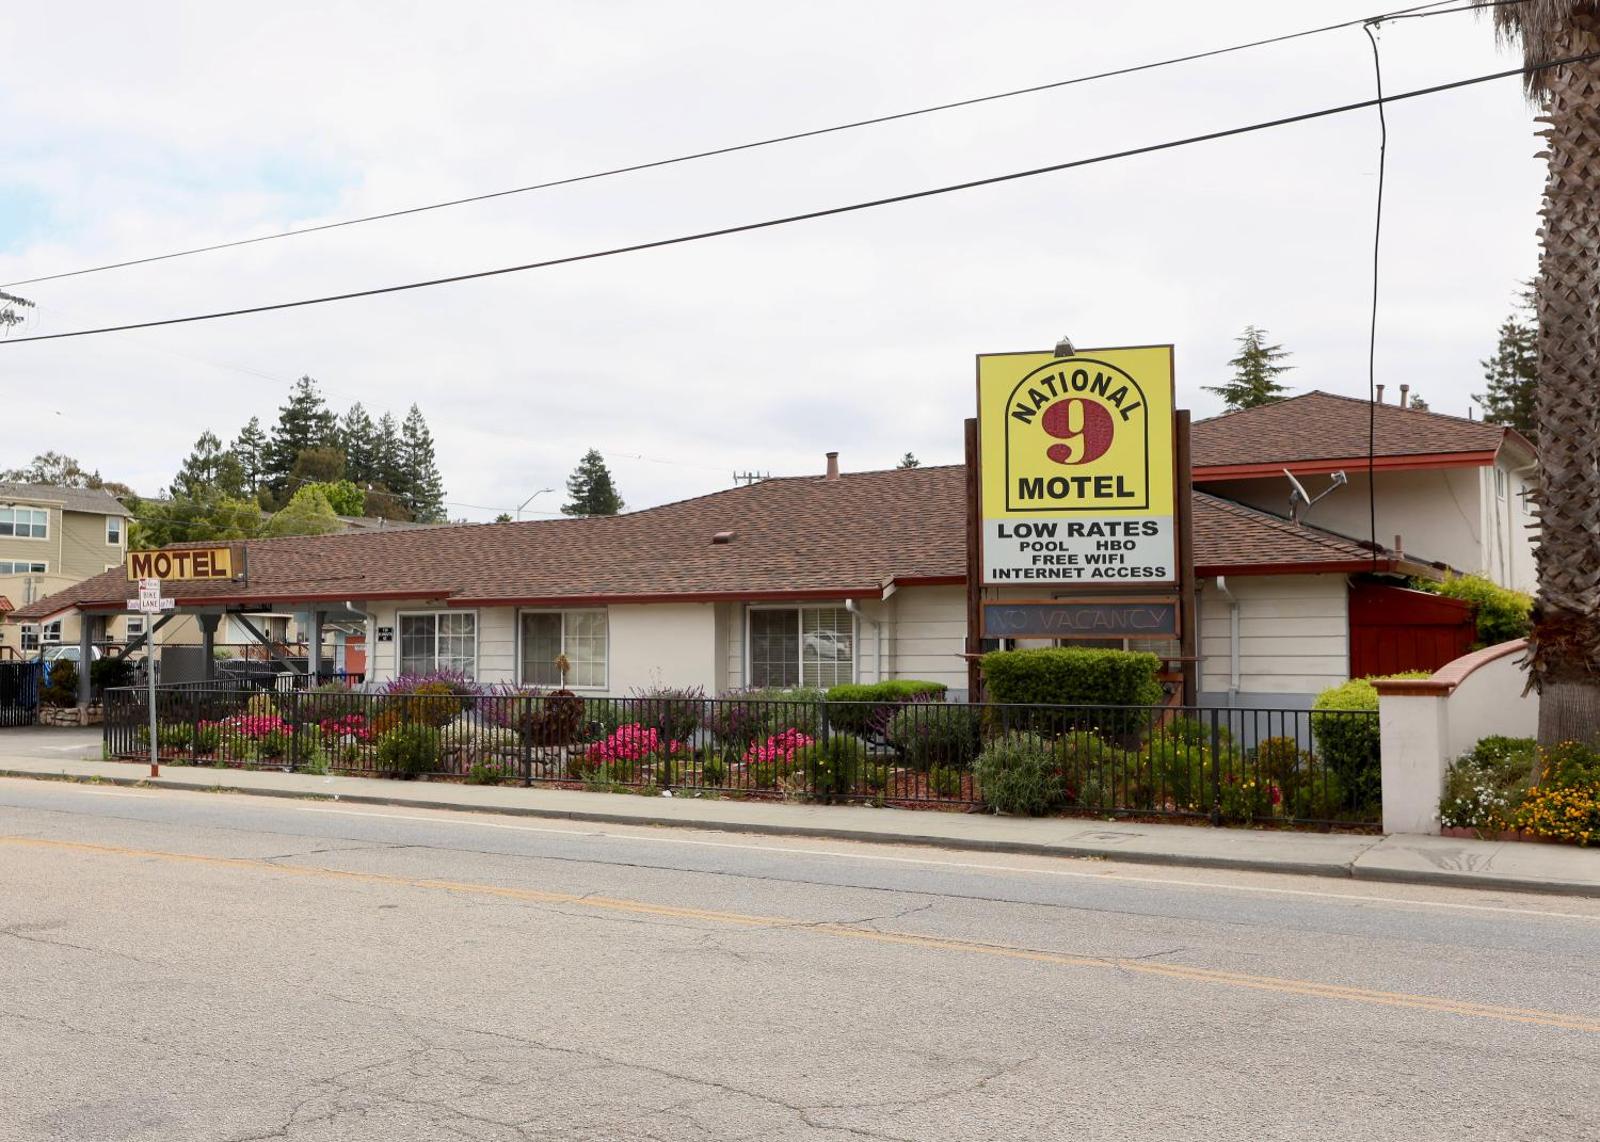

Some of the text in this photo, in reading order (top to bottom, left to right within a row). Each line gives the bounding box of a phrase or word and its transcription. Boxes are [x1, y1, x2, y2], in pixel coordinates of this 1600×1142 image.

[1011, 368, 1143, 424] NATIONAL
[1041, 397, 1115, 465] 9
[1018, 475, 1135, 500] MOTEL
[997, 520, 1159, 539] LOW RATES
[1019, 539, 1136, 552] POOL HBO
[131, 550, 227, 579] MOTEL
[1032, 553, 1125, 566] FREE WIFI
[992, 566, 1167, 580] INTERNET ACCESS
[142, 600, 157, 608] LANE
[992, 608, 1168, 629] NO VACANCY
